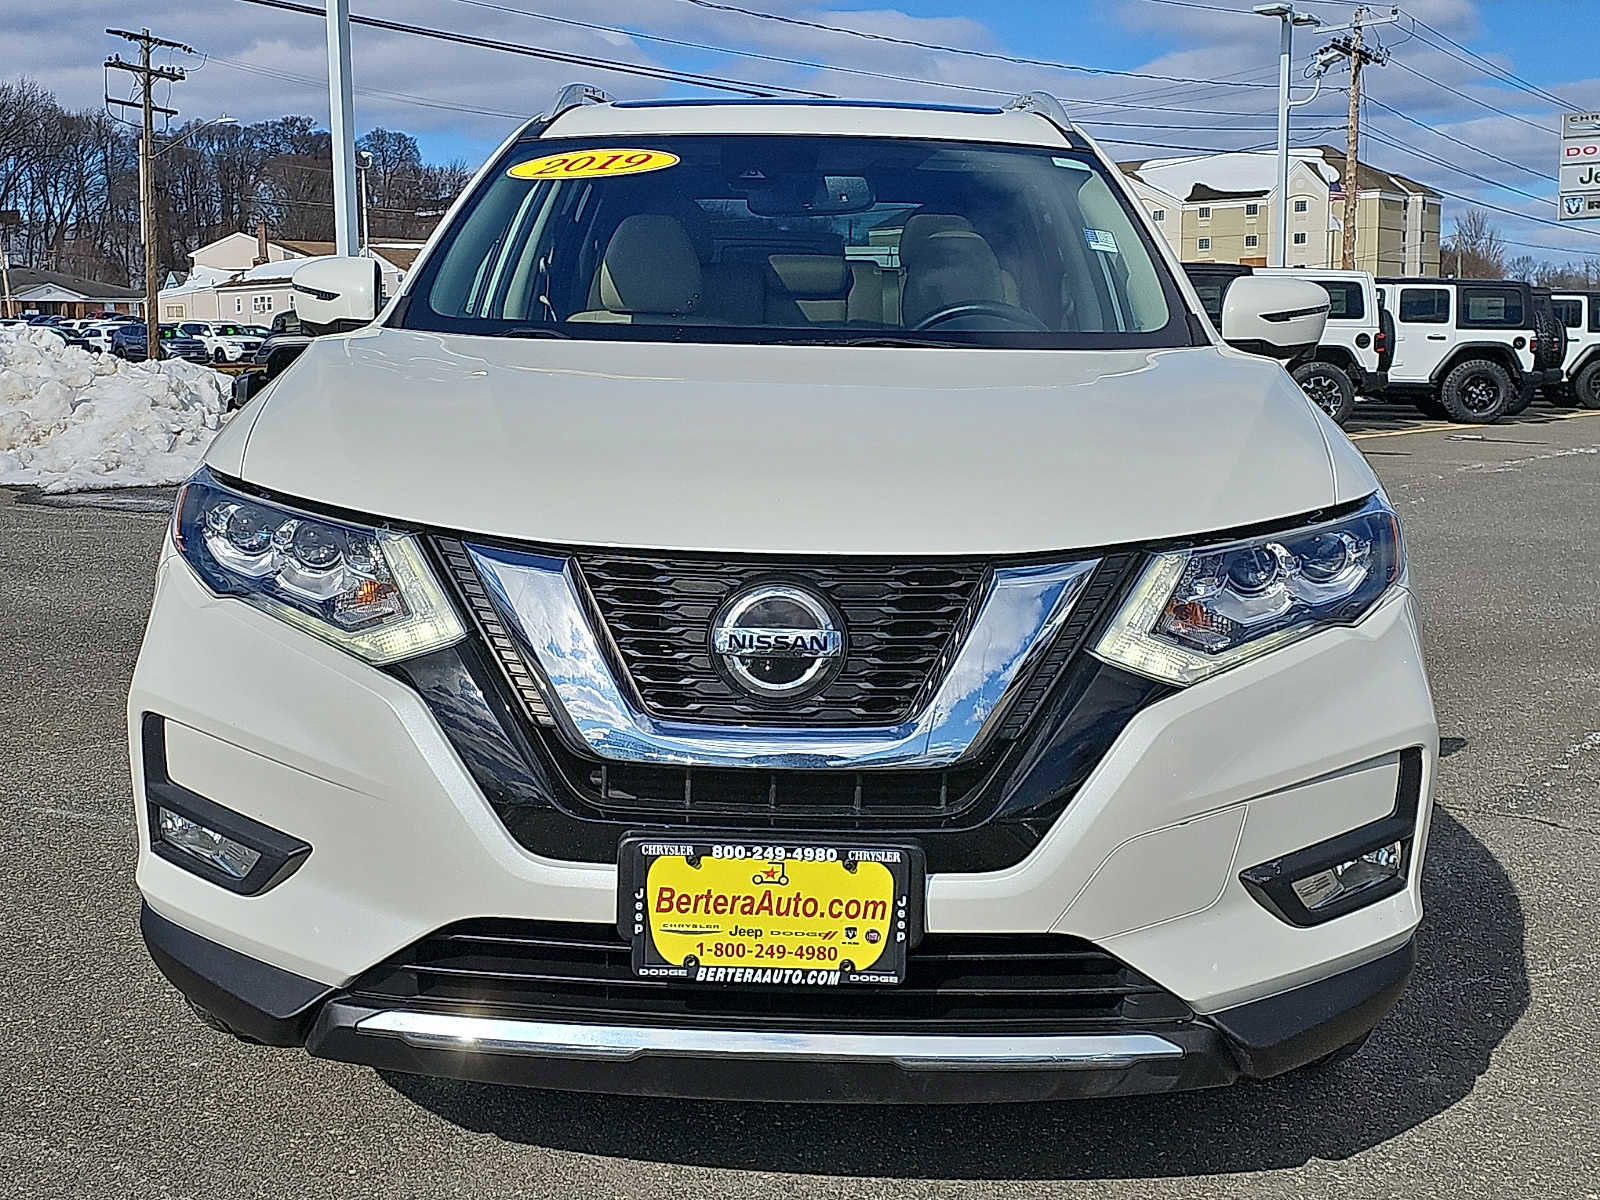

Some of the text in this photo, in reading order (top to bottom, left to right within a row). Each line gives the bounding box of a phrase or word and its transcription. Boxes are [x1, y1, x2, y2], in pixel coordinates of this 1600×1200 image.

[1566, 146, 1598, 157] DO
[534, 153, 653, 175] 2019
[728, 634, 828, 651] NISSAN
[641, 844, 695, 856] CHRYSLER
[711, 845, 838, 861] 800-249-4980
[848, 850, 901, 863] CHRYSLER
[634, 888, 644, 934] Jeep
[656, 887, 887, 920] BerteraAuto.com
[897, 896, 907, 942] Jeep
[729, 925, 763, 939] Jeep
[696, 942, 838, 961] 1-800-249-4980
[639, 968, 688, 977] DODGE
[696, 967, 840, 985] BERTERAAUTO.COM
[849, 974, 898, 983] DODGE
